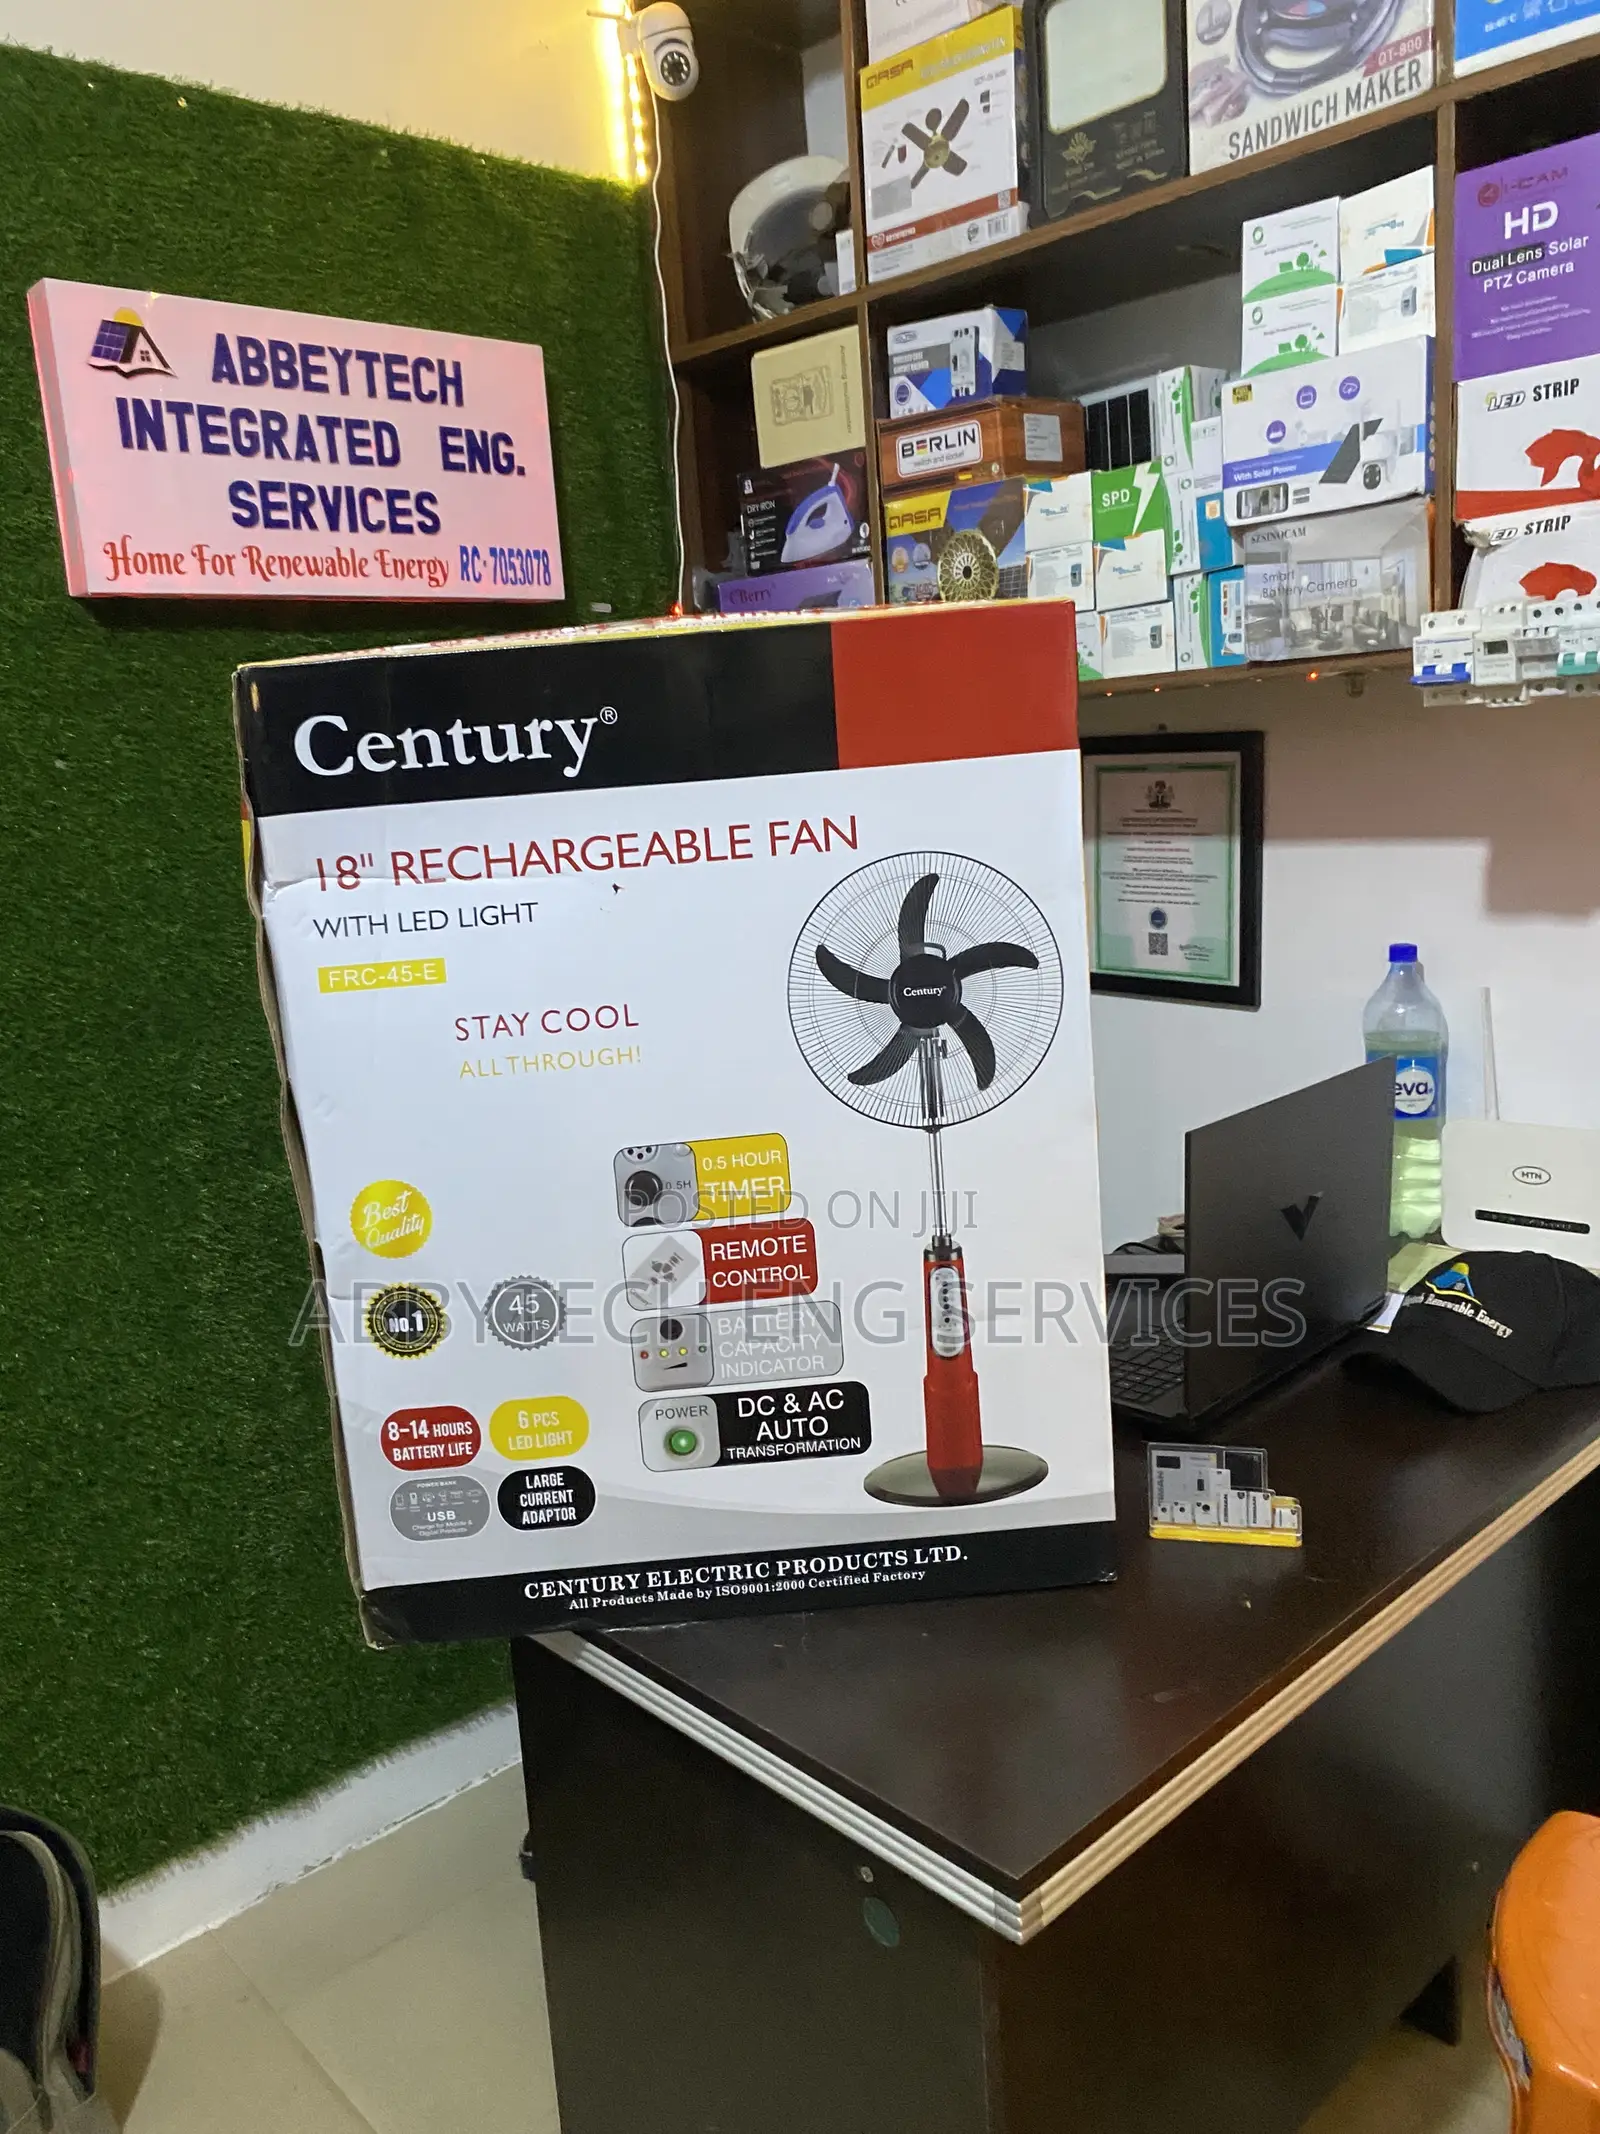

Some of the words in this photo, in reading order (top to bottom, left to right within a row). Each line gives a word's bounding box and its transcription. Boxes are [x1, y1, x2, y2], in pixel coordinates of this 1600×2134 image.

[1378, 36, 1422, 66] QT-800
[866, 59, 913, 89] QASA
[1229, 95, 1338, 160] SANDWICH
[1345, 59, 1422, 116] MAKER
[1504, 201, 1558, 239] HD
[1472, 255, 1504, 275] Dual
[1508, 247, 1542, 266] Lens
[1549, 236, 1589, 255] Solar
[1484, 274, 1513, 293] PTZ
[1516, 261, 1574, 284] Camera
[212, 333, 465, 407] ABBEYTECH
[1487, 390, 1526, 412] LED
[1533, 378, 1580, 402] STRIP
[116, 397, 401, 467] INTEGRATED
[439, 425, 527, 477] ENG.
[901, 428, 976, 459] BERLIN
[229, 480, 442, 535] SERVICES
[1102, 489, 1130, 507] SPD
[889, 507, 941, 529] QASA
[1524, 515, 1571, 535] STRIP
[103, 535, 188, 581] Home
[192, 544, 236, 577] For
[242, 544, 369, 582] Renewable
[374, 549, 450, 588] Energy
[1262, 570, 1295, 584] Smart
[1306, 579, 1358, 594] Camera
[392, 823, 752, 886] RECHARGEABLE
[768, 815, 859, 857] FAN
[313, 911, 388, 940] WITH
[398, 907, 449, 934] LED
[457, 902, 538, 929] LIGHT
[328, 963, 438, 989] FRC-45-E
[454, 1011, 530, 1042] STAY
[540, 1003, 639, 1035] COOL
[702, 1157, 727, 1171] 0.5
[732, 1150, 782, 1168] HOUR
[1521, 1171, 1542, 1180] MTN
[704, 1176, 785, 1203] TIMER
[362, 1190, 412, 1230] Best
[366, 1214, 425, 1249] Quality
[710, 1235, 808, 1261] REMOTE
[712, 1265, 810, 1288] CONTROL
[508, 1294, 540, 1315] 45
[503, 1317, 550, 1333] WATTS
[718, 1311, 821, 1335] BATTERY
[1475, 1309, 1513, 1338] Energy
[719, 1335, 822, 1358] CAPACITY
[720, 1355, 825, 1379] INDICATOR
[655, 1406, 709, 1420] POWER
[738, 1395, 774, 1418] DC
[783, 1393, 801, 1413] &
[808, 1389, 844, 1412] AC
[387, 1419, 429, 1441] 8-14
[433, 1421, 473, 1438] HOURS
[518, 1410, 528, 1429] 6
[533, 1412, 559, 1428] PCS
[757, 1416, 828, 1442] AUTO
[393, 1444, 445, 1462] BATTERY
[449, 1442, 473, 1456] LIFE
[508, 1435, 532, 1451] LED
[535, 1431, 573, 1449] LIGHT
[727, 1437, 861, 1460] TRANSFORMATION
[525, 1472, 565, 1489] LARGE
[519, 1489, 574, 1507] CURRENT
[427, 1511, 456, 1522] USB
[522, 1507, 577, 1525] ADAPTOR
[524, 1573, 640, 1599] CENTURY
[647, 1561, 771, 1588] ELECTRIC
[777, 1550, 908, 1578] PRODUCTS
[913, 1545, 968, 1564] LTD.
[569, 1599, 589, 1611] All
[592, 1593, 655, 1609] Products
[657, 1589, 694, 1602] Made
[696, 1587, 712, 1600] by
[715, 1578, 805, 1597] ISO9001:2000
[808, 1573, 870, 1590] Certified
[873, 1569, 925, 1584] Factory
